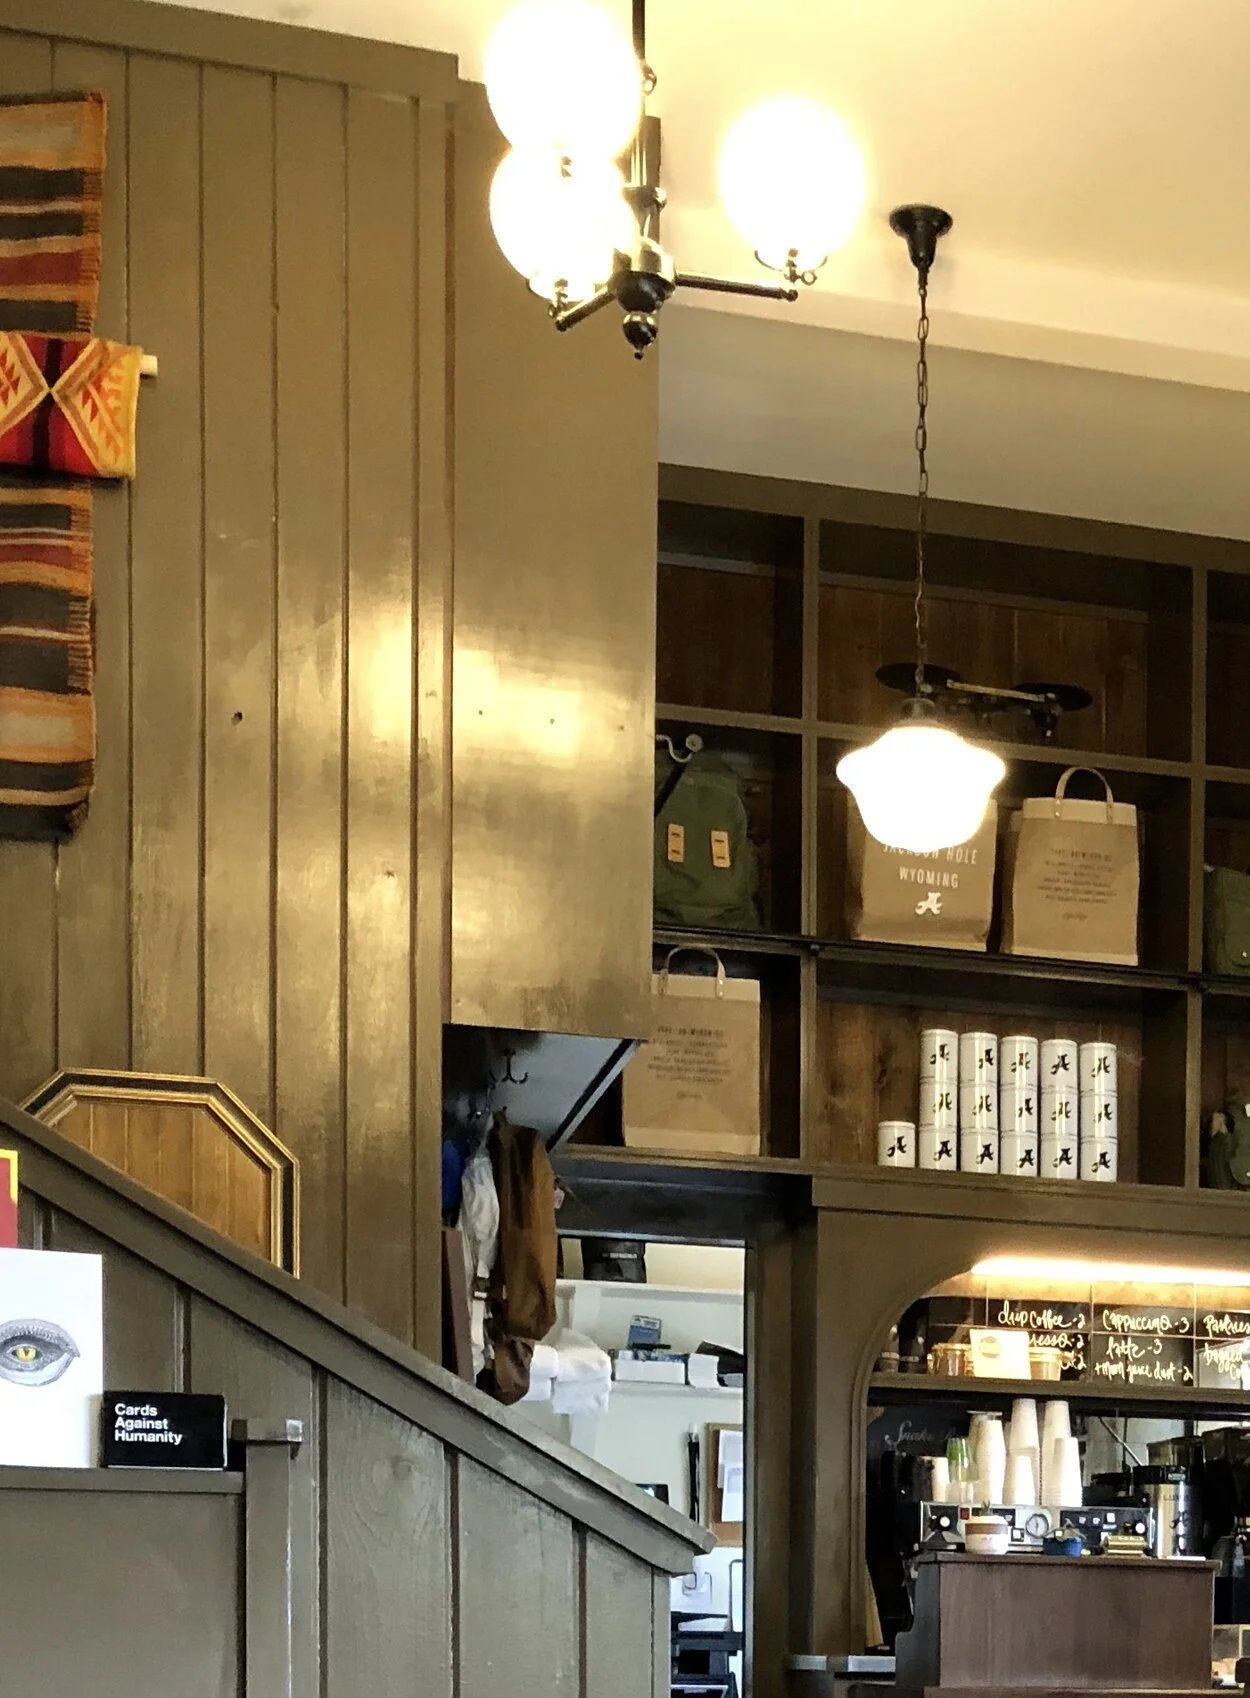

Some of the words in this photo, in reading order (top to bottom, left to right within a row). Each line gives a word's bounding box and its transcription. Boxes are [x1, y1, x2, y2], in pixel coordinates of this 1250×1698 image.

[946, 846, 978, 865] HOLE
[899, 866, 959, 889] WYOMING
[998, 1300, 1028, 1326] drip
[1029, 1309, 1072, 1329] Coffee
[1103, 1309, 1172, 1335] Cappuccino
[1106, 1336, 1145, 1362] latte
[114, 1403, 158, 1416] Cards
[114, 1416, 169, 1431] Against
[114, 1429, 183, 1446] Humanity
